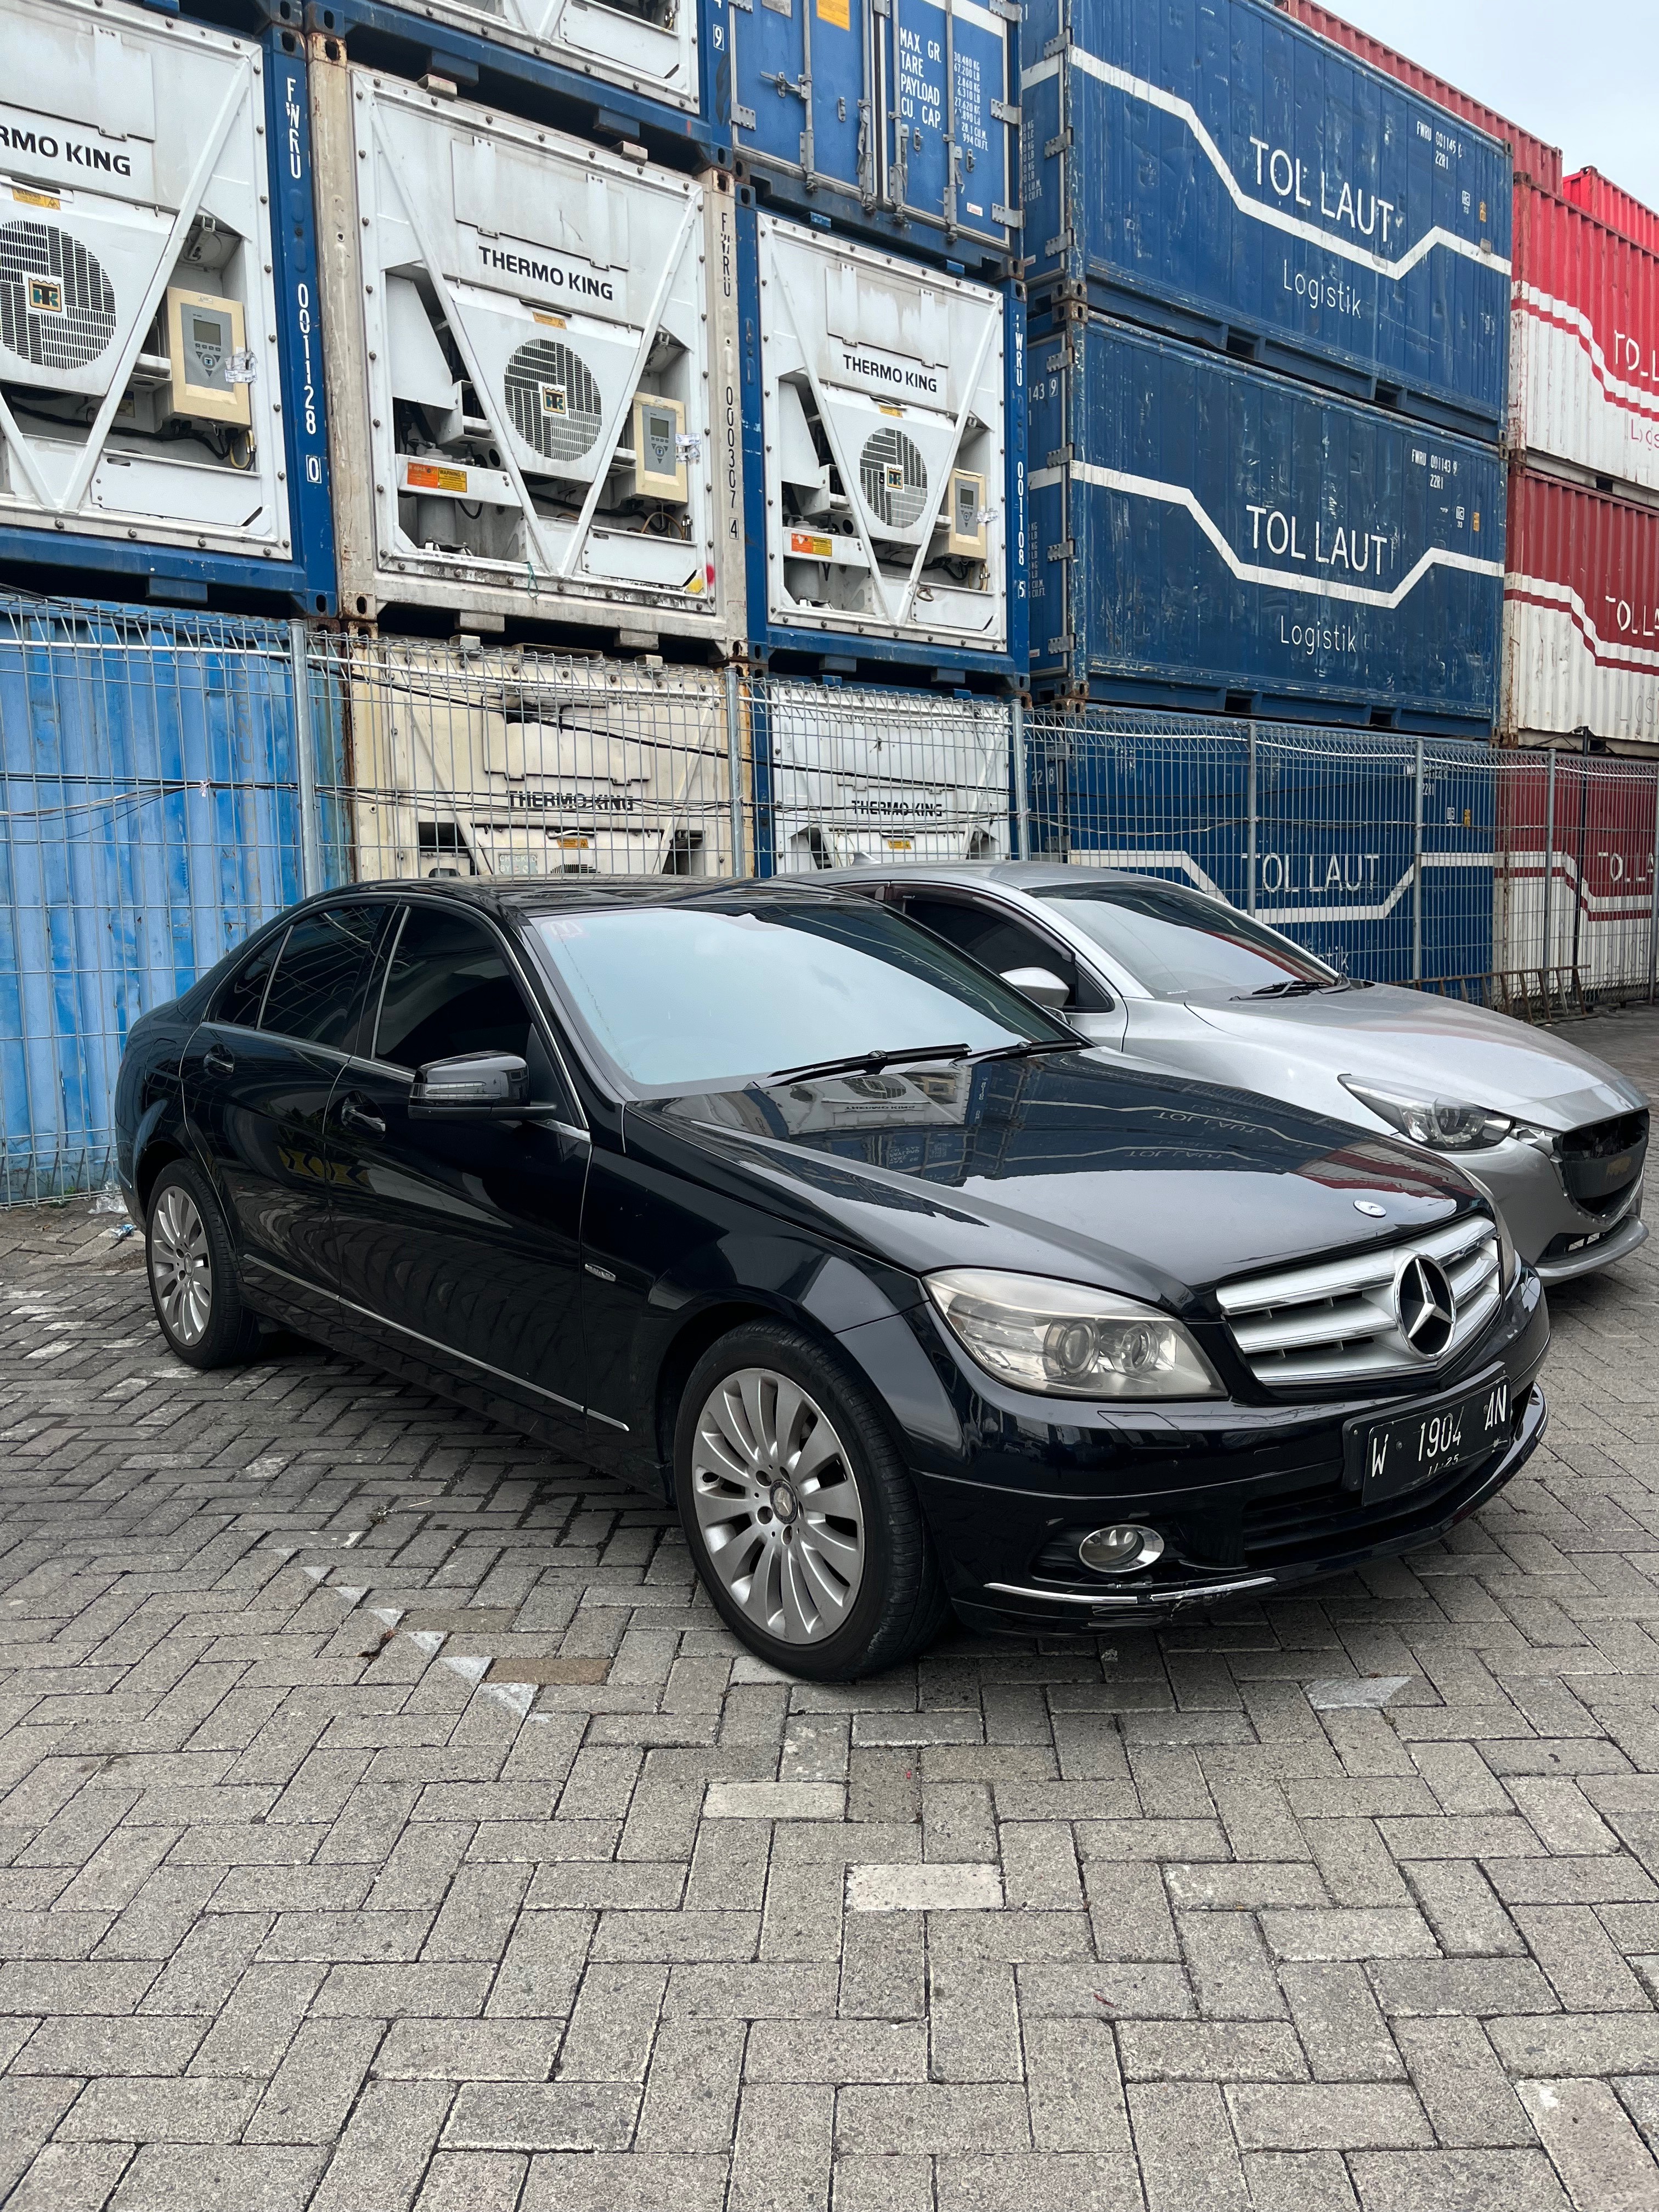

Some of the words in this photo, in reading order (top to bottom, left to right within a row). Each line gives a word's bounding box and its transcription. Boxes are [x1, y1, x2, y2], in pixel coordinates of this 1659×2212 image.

[715, 27, 722, 47] 9
[900, 27, 922, 54] MAX.
[928, 40, 941, 63] GR.
[900, 50, 924, 77] TARE
[973, 60, 980, 72] KG
[974, 71, 980, 82] LB
[901, 73, 940, 106] PAYLOAD
[974, 82, 980, 93] KG
[974, 93, 980, 104] LB
[285, 77, 301, 179] FWRU
[901, 97, 916, 119] CU.
[922, 105, 942, 130] CAP.
[963, 133, 973, 145] 994
[66, 142, 131, 177] KING
[1250, 136, 1311, 206] TOL
[1321, 171, 1394, 242] LAUT
[479, 245, 563, 286] THERMO
[569, 272, 613, 301] KING
[1284, 259, 1361, 319] Logistik
[298, 283, 316, 435] 001128
[843, 354, 902, 383] THERMO
[906, 371, 937, 393] KING
[1051, 379, 1057, 396] 9
[726, 386, 736, 509] 000307
[730, 520, 737, 538] 4
[1246, 505, 1306, 560] TOL
[1316, 521, 1387, 575] LAUT
[1281, 615, 1357, 655] Logistik
[506, 790, 587, 809] THERMO
[592, 794, 634, 811] KING
[851, 800, 909, 817] THERMO
[912, 803, 943, 817] KING
[1310, 854, 1379, 893] LAUT
[1372, 1434, 1389, 1477] W
[1418, 1406, 1465, 1462] 1904
[1485, 1384, 1507, 1431] AN
